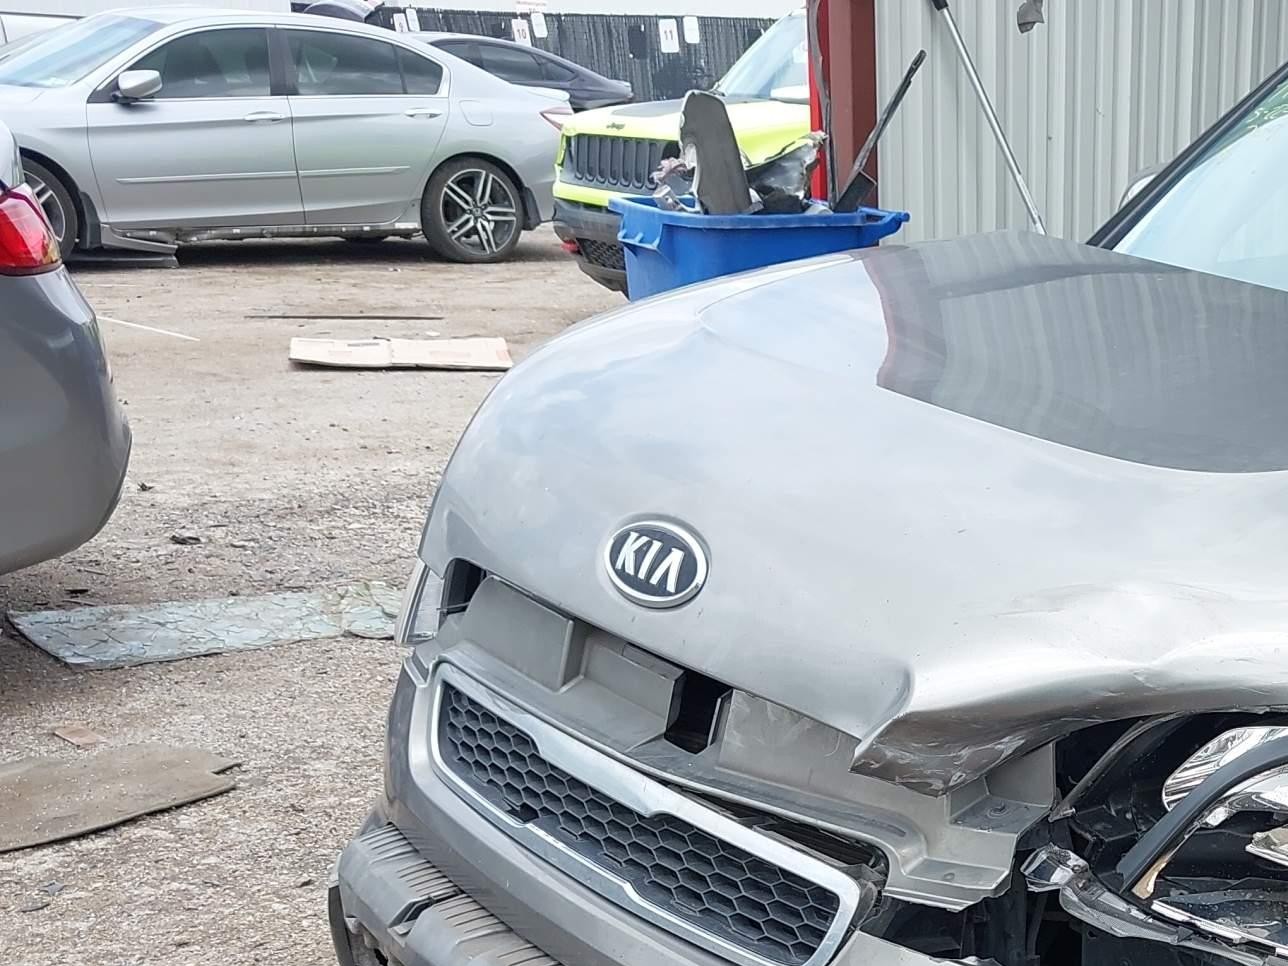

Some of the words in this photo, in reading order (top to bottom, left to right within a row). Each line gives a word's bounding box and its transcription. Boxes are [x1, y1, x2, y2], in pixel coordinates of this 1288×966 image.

[516, 28, 527, 40] 10
[663, 29, 674, 41] 11
[615, 531, 685, 593] KIA
